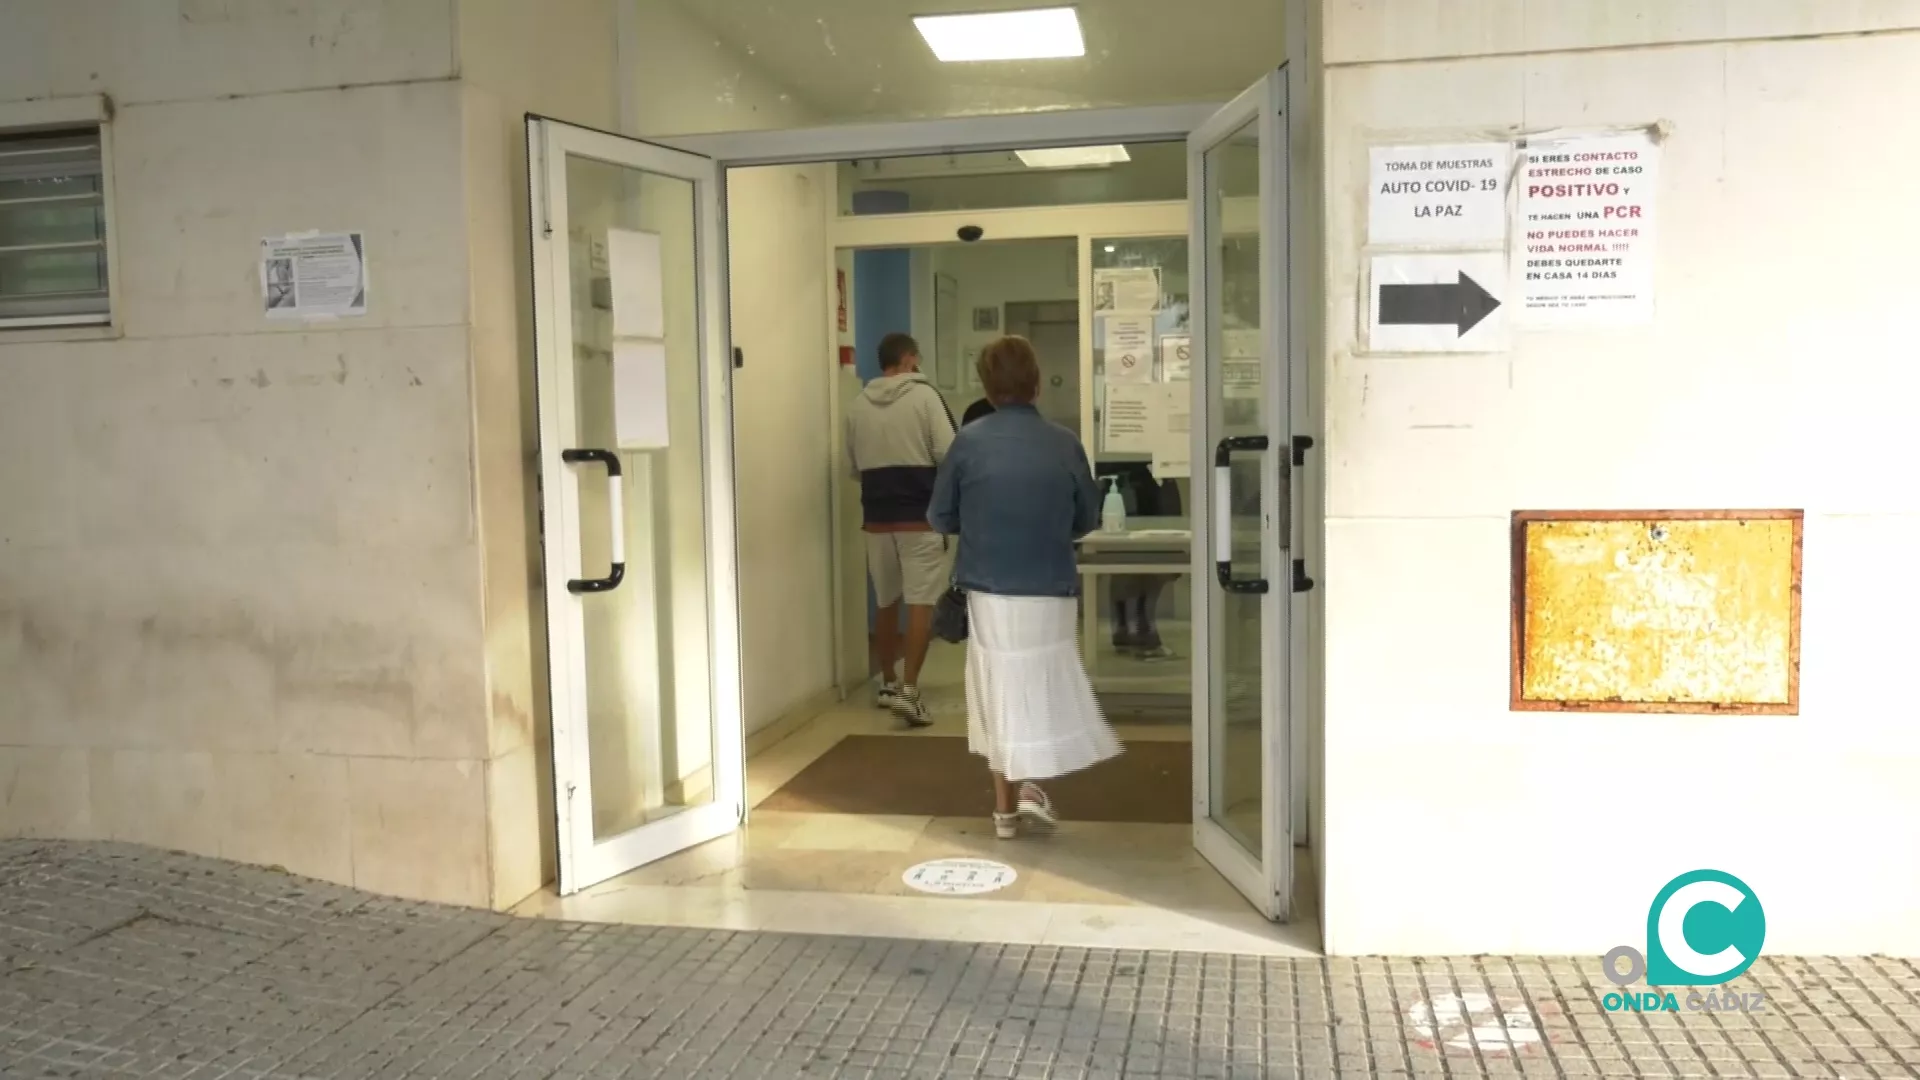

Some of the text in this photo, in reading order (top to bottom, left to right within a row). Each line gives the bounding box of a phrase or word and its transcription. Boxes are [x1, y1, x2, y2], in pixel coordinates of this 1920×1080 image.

[1529, 151, 1638, 163] SI ERES CONTACTO
[1385, 158, 1493, 172] TOMA DE MUESTRAS
[1528, 166, 1643, 177] ESTRECHO DE CASO
[1380, 178, 1497, 194] AUTO COVID- 19
[1528, 183, 1619, 198] POSITIVO
[1414, 204, 1463, 218] LA PAZ
[1577, 211, 1599, 219] UNA
[1603, 205, 1642, 218] PCR
[1527, 228, 1639, 239] NO PUEDES HACER
[1527, 244, 1554, 253] VIDA
[1558, 243, 1608, 252] NORMAL
[1527, 258, 1622, 267] DEBES QUEDARTE
[1526, 271, 1617, 280] EN CASA 14 DIAS
